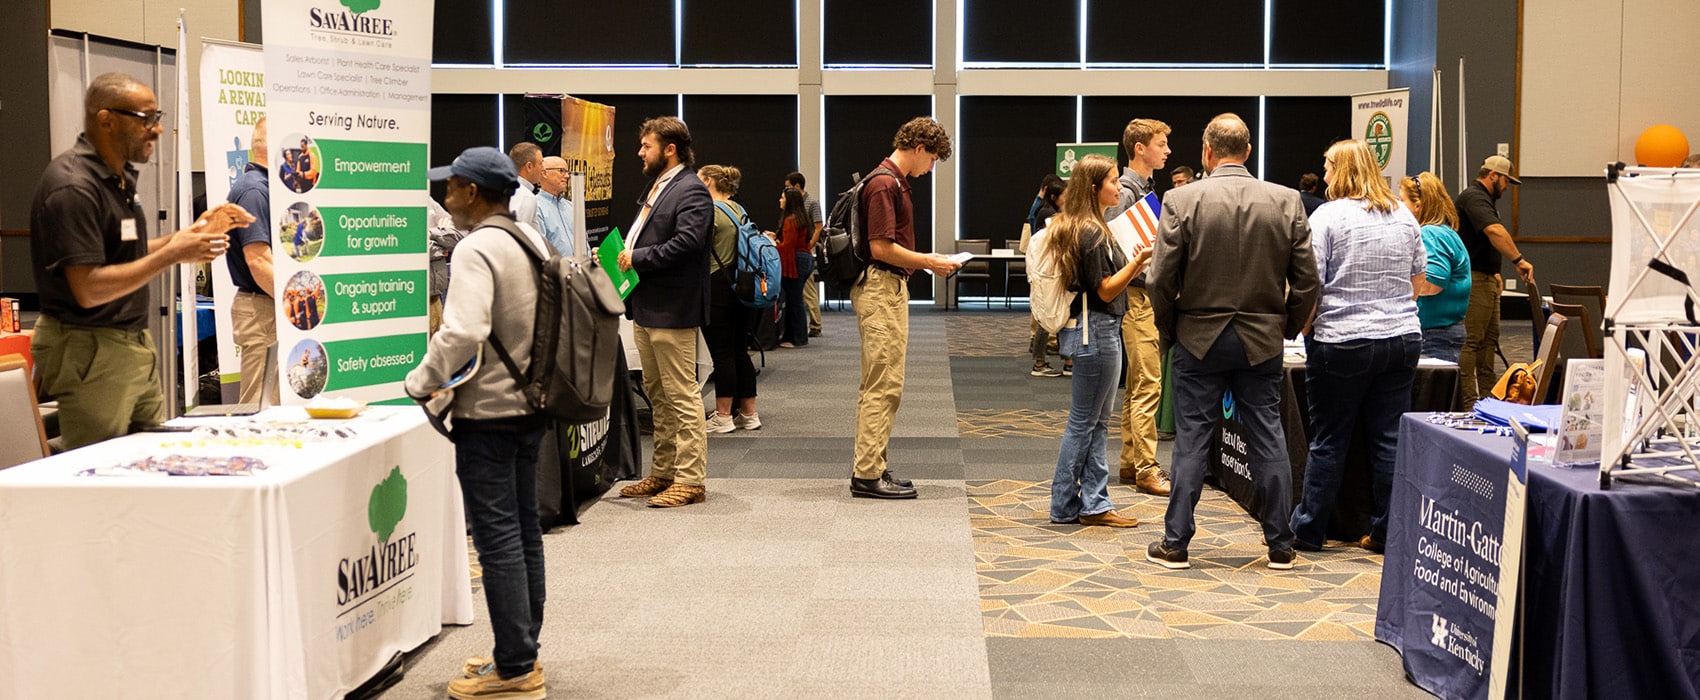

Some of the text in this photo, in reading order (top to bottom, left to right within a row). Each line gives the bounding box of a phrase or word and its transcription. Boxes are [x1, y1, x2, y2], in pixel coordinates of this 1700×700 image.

[376, 40, 392, 48] Care
[286, 54, 420, 74] Sales Arborist Plant Health Care Specialist
[219, 69, 264, 88] LOOKIN
[297, 70, 409, 87] Lawn Care Specialist Tree Climber
[218, 88, 228, 104] A
[272, 83, 429, 103] Operations Office Administration Management
[308, 111, 400, 131] Serving Nature.
[334, 158, 411, 175] Empowerment
[338, 214, 408, 231] Opportunities
[347, 234, 399, 251] for growth
[334, 278, 415, 298] Ongoing training
[351, 298, 397, 316] & support
[337, 351, 414, 373] Safety obsessed
[1418, 536, 1452, 569] College
[1453, 556, 1464, 573] of
[1414, 558, 1440, 587] Food
[1440, 576, 1458, 596] and
[1447, 635, 1484, 676] Kentucky
